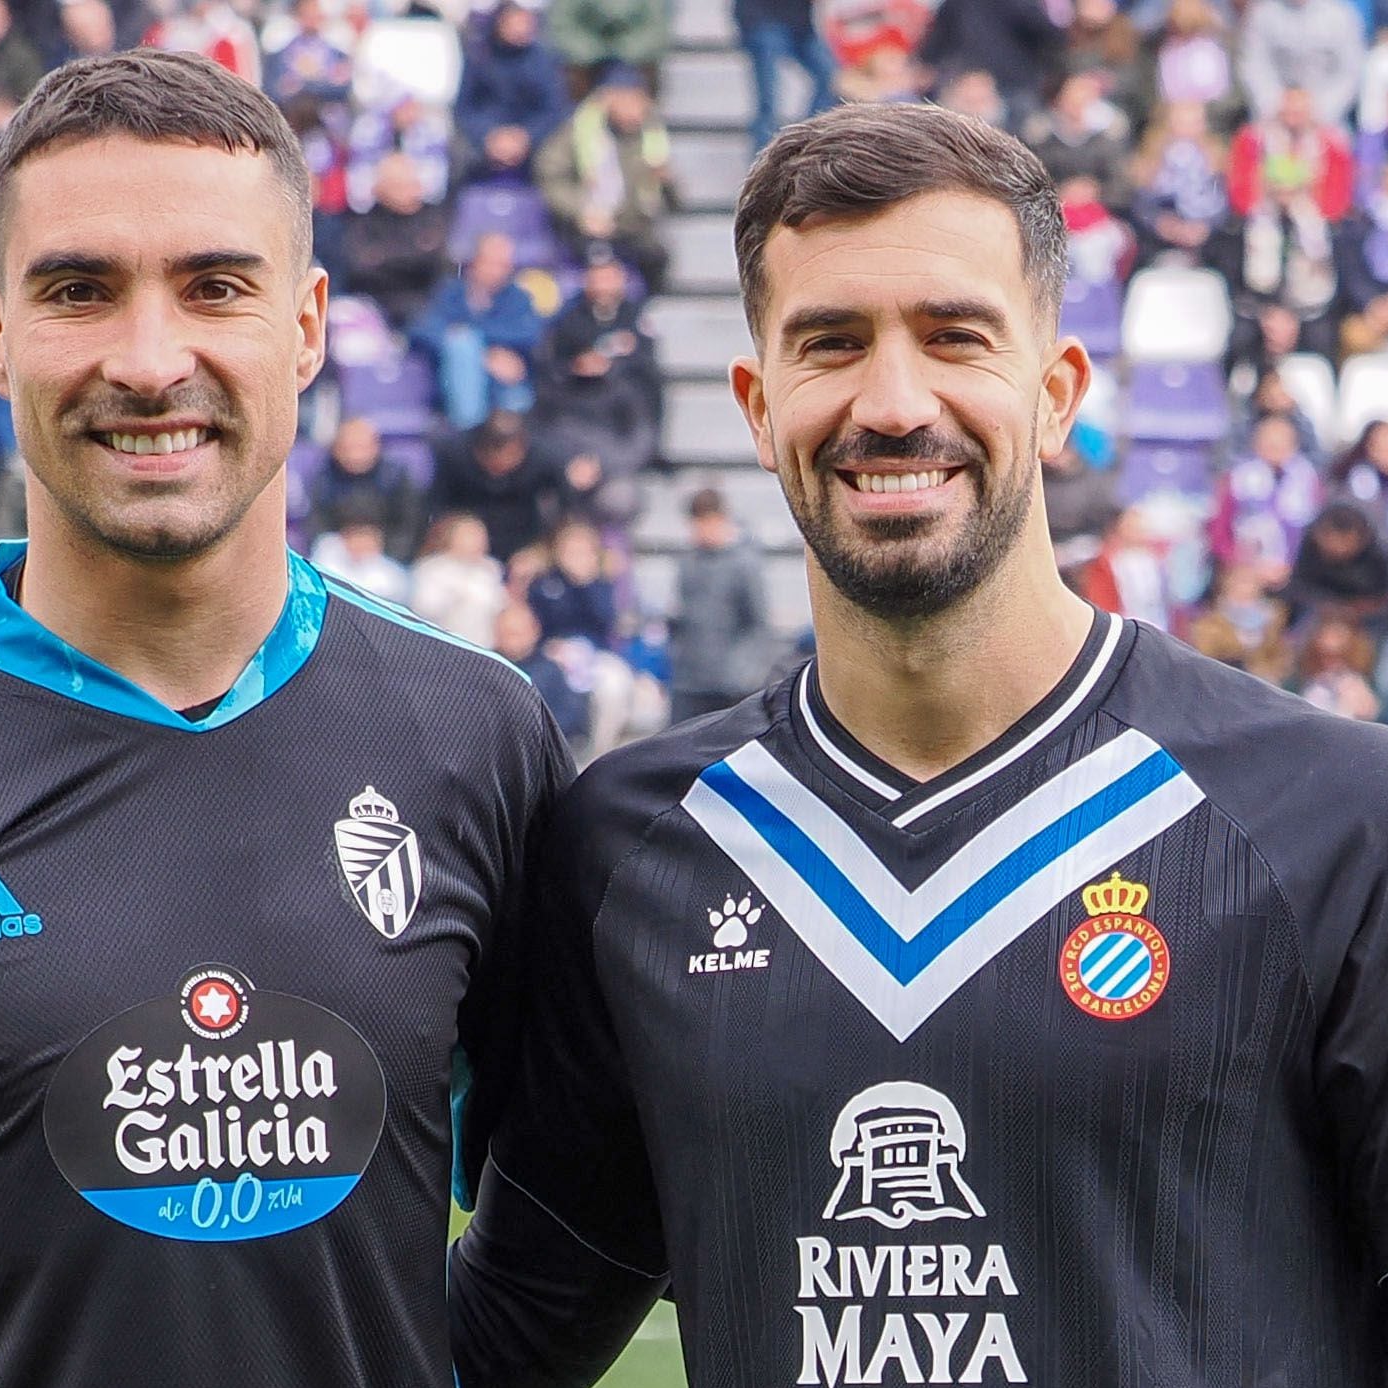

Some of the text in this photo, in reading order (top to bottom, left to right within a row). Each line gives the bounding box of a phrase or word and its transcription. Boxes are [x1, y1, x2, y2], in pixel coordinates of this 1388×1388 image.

[688, 949, 770, 974] KELME
[1066, 917, 1164, 960] RCD ESPANYOL
[1066, 971, 1165, 1014] DE BARCELONA
[102, 1040, 337, 1111] Estrella
[115, 1103, 331, 1175] Galicia
[796, 1236, 1019, 1298] RIVIERA
